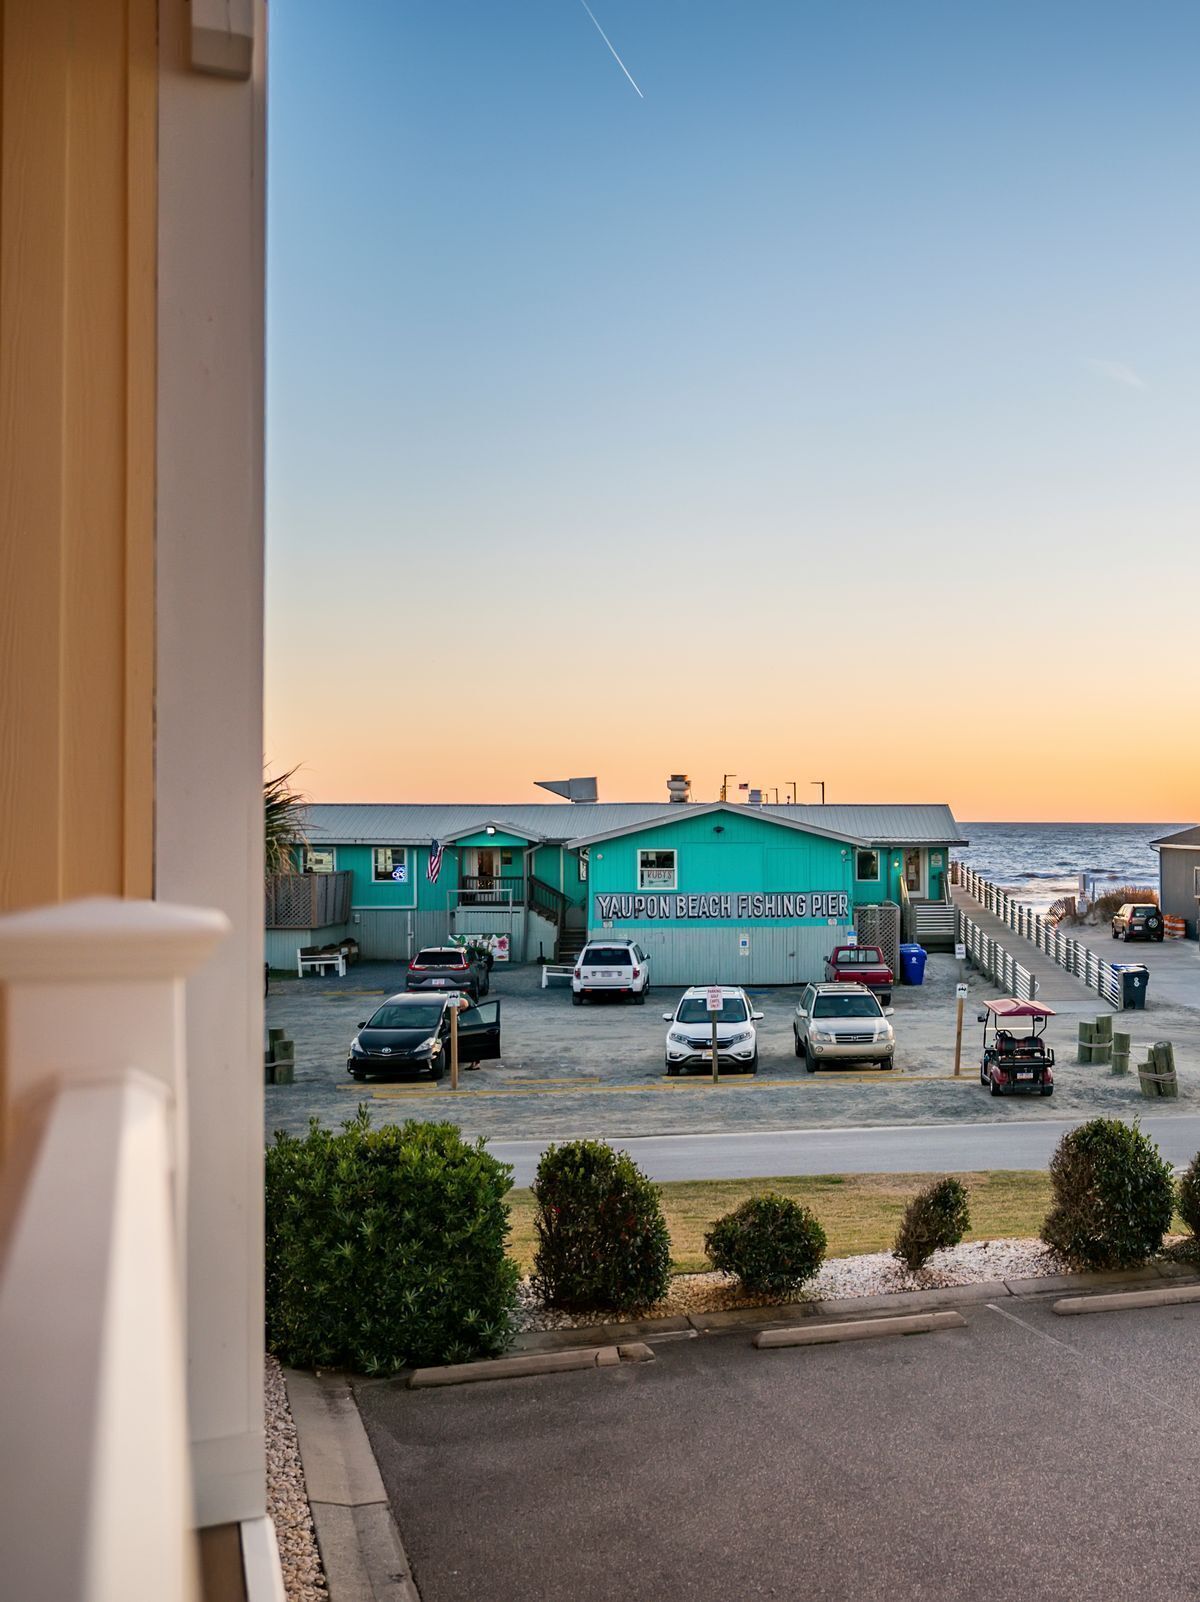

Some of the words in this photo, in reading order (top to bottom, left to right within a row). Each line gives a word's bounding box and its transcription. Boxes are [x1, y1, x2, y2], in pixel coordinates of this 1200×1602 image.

[598, 895, 670, 918] YAUPON
[676, 895, 731, 918] BEACH
[737, 895, 807, 918] FISHING
[811, 894, 848, 917] PIER
